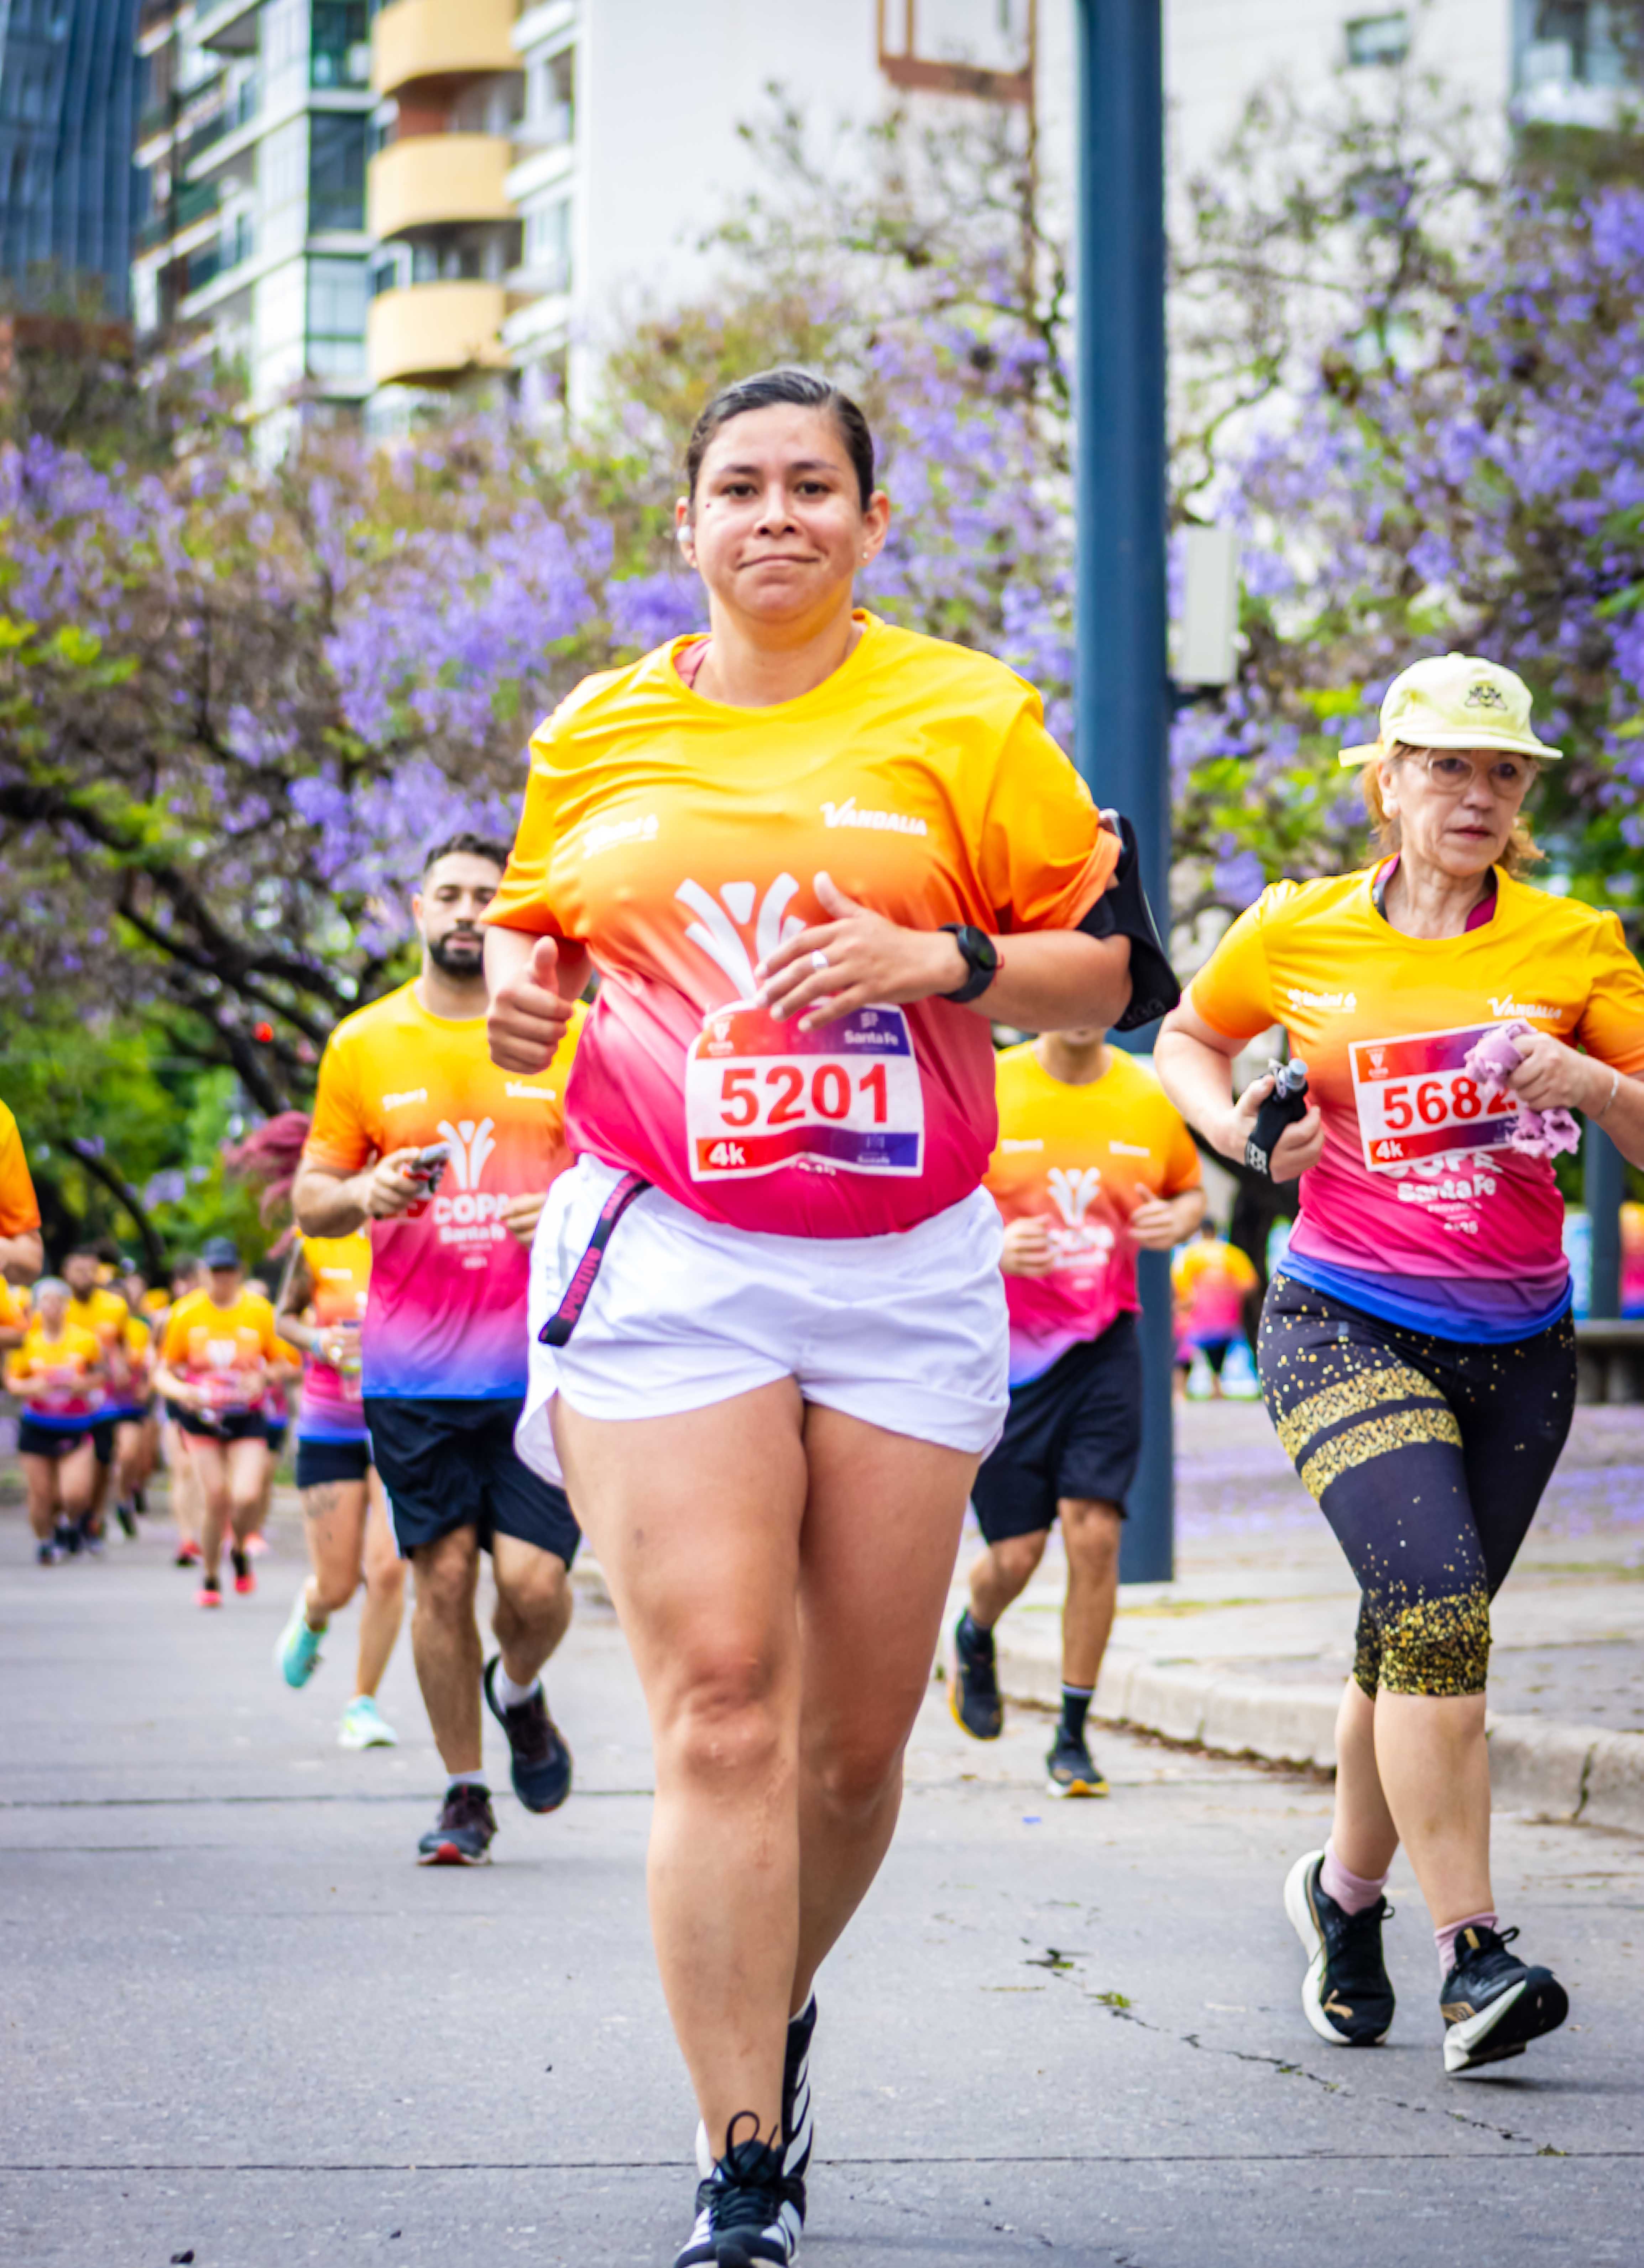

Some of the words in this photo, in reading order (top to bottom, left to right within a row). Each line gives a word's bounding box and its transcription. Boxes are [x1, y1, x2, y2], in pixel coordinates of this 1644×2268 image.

[720, 1063, 887, 1127] 5201
[709, 1142, 747, 1166] 4k
[1376, 1140, 1404, 1159] 4k
[1397, 1179, 1472, 1202] Santa
[1473, 1174, 1496, 1197] Fe
